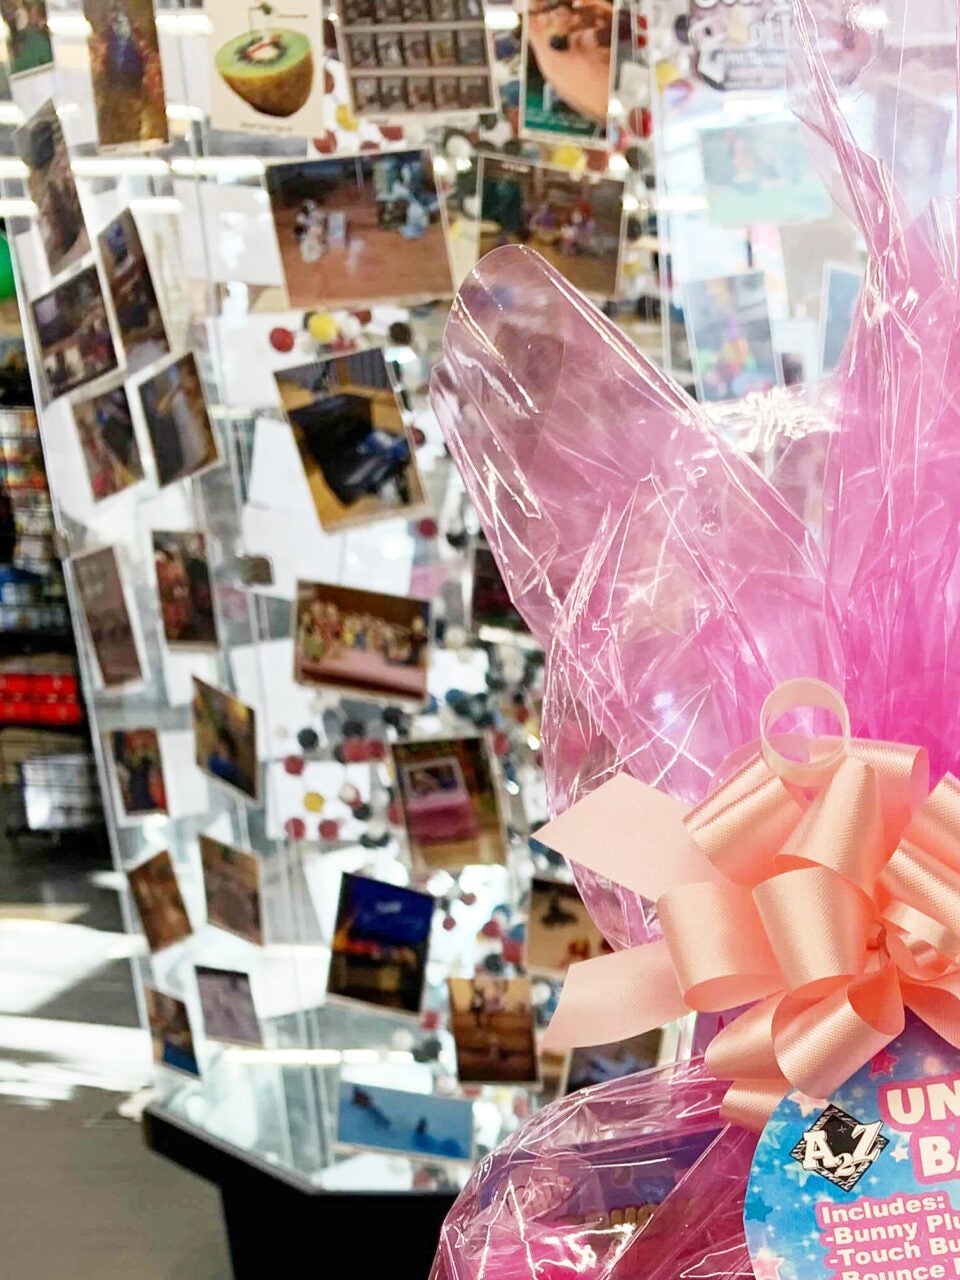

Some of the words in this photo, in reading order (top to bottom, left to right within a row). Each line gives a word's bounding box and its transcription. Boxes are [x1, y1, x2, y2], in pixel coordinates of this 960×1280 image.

[820, 1196, 946, 1224] Includes:
[825, 1220, 919, 1246] -Bunny
[829, 1241, 921, 1267] -Touch
